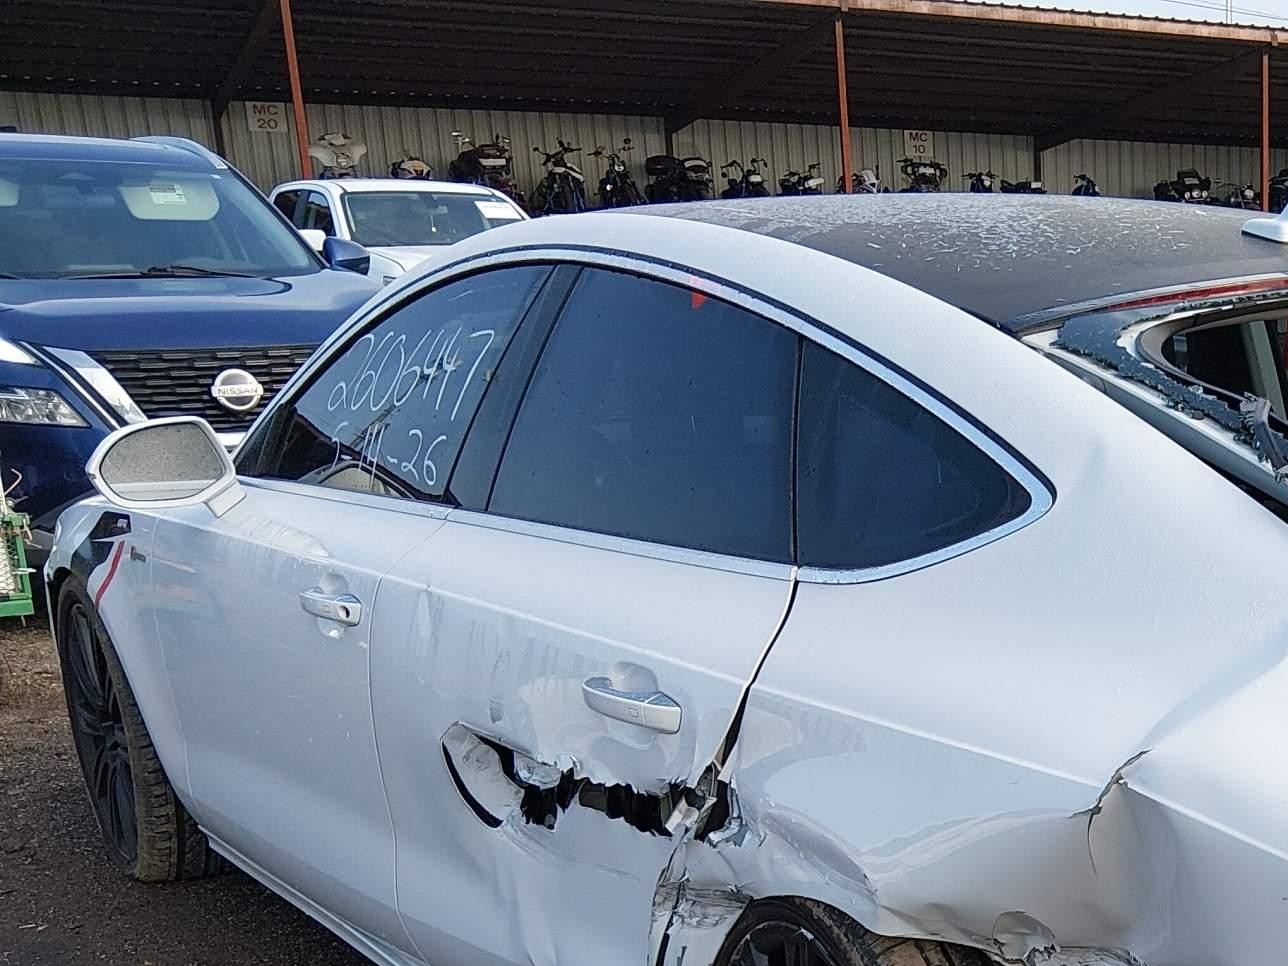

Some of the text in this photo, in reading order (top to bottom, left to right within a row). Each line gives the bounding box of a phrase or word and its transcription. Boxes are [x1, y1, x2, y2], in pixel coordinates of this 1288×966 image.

[253, 104, 278, 115] MC
[257, 118, 278, 129] 20
[909, 132, 928, 142] MC
[913, 144, 926, 154] 10
[328, 327, 495, 421] 2606447
[217, 386, 258, 395] NISSAN
